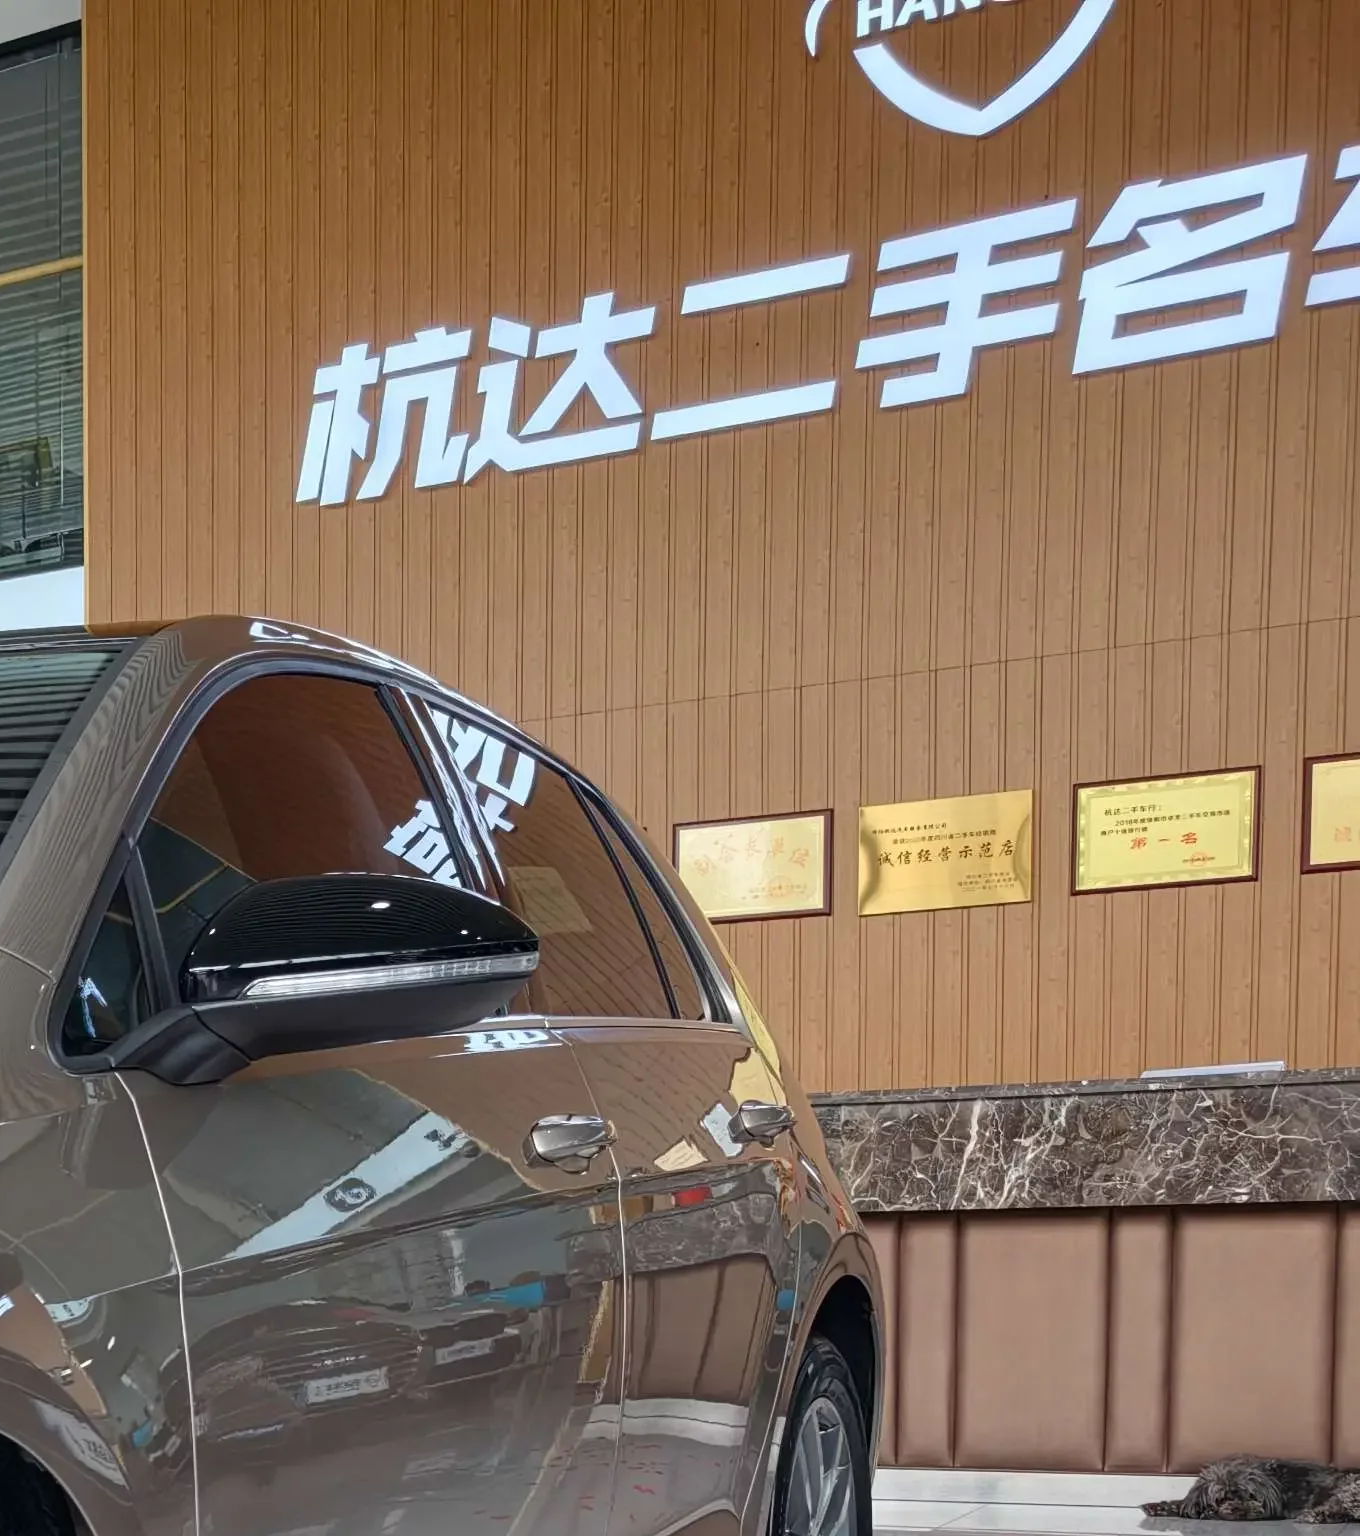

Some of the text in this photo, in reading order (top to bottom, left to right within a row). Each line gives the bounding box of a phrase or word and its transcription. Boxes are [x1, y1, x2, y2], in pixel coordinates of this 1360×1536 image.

[295, 145, 1360, 507] 杭达二手名
